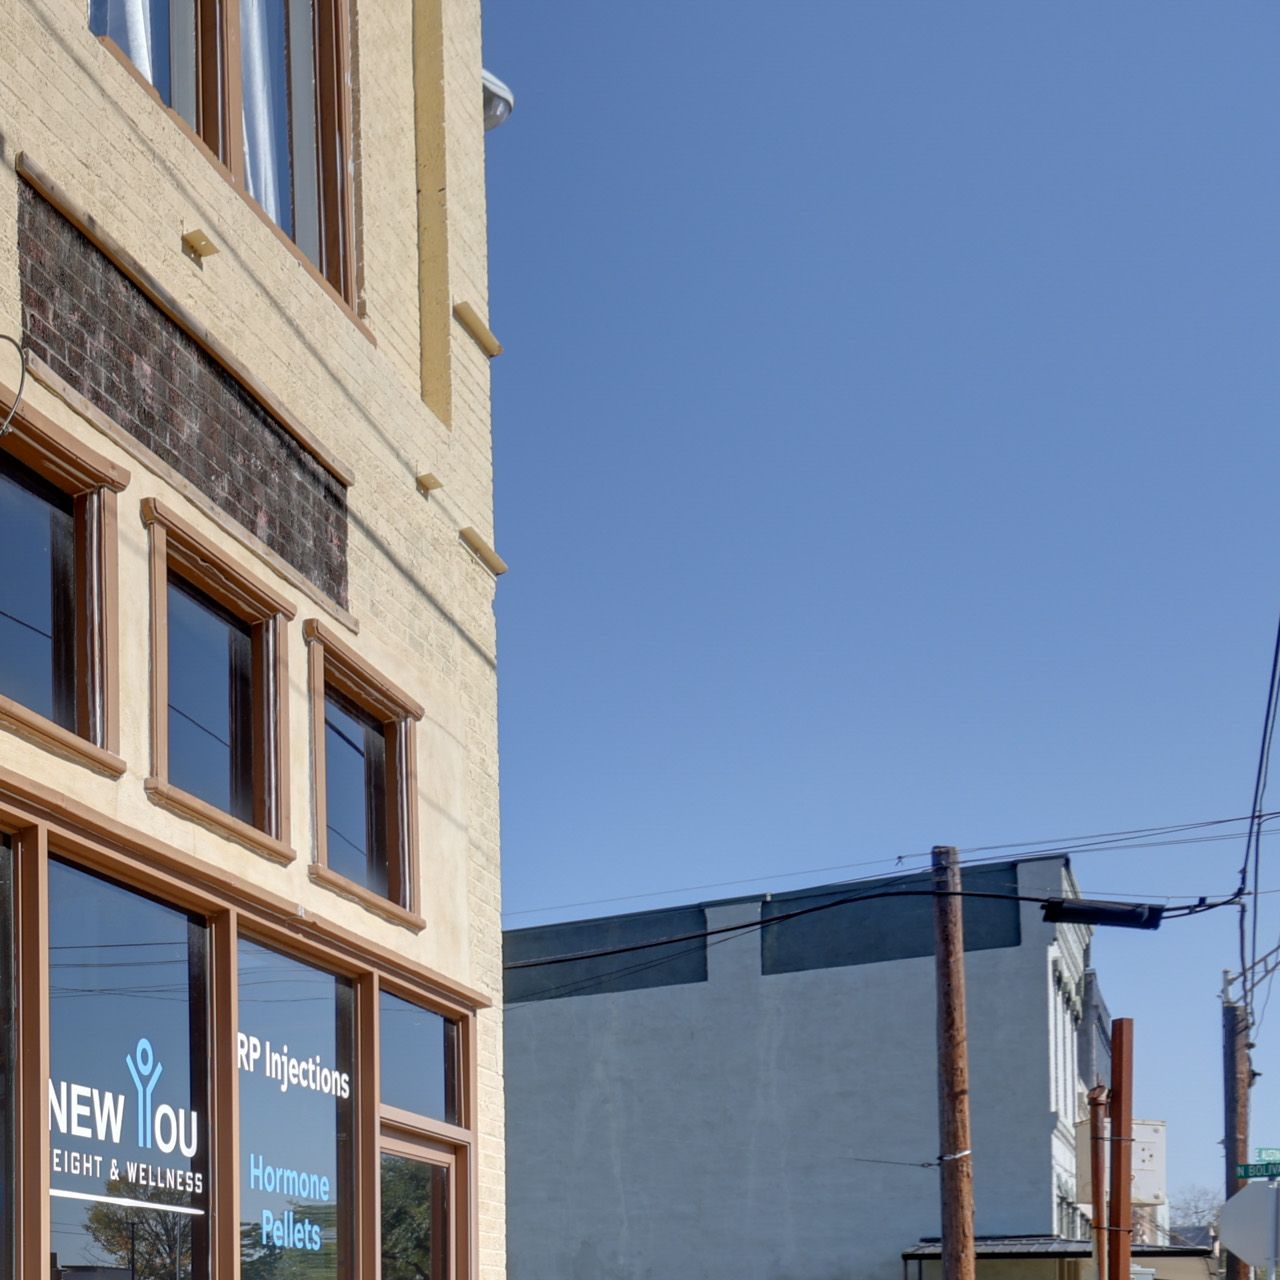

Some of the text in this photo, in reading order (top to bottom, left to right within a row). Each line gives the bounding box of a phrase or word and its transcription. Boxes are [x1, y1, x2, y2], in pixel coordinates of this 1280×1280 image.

[265, 1040, 350, 1099] Injections
[48, 1038, 197, 1157] NEW YOU
[52, 1148, 203, 1193] EIGHT & WELLNESS
[249, 1153, 330, 1201] Hormone
[262, 1210, 322, 1251] Pellets
